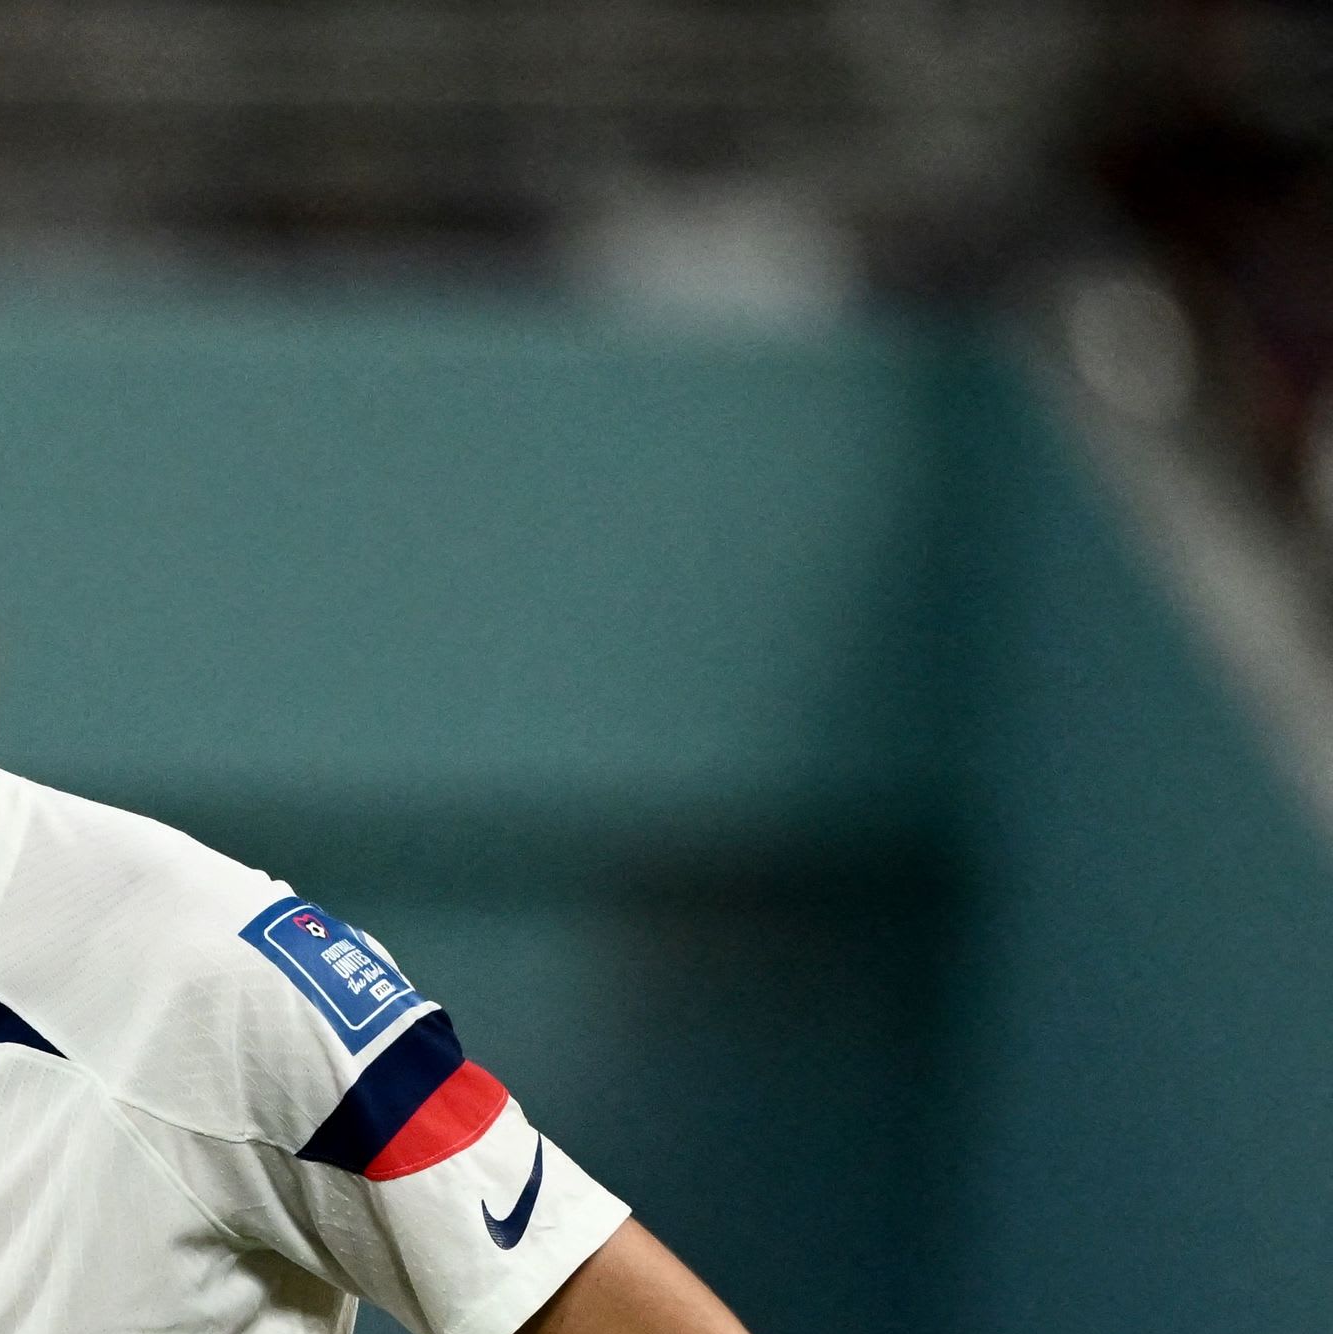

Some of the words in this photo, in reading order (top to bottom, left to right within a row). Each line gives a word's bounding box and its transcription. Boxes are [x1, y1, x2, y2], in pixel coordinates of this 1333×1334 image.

[320, 939, 356, 965] FOOTBALL
[332, 949, 371, 979] UNITES
[347, 977, 367, 995] the
